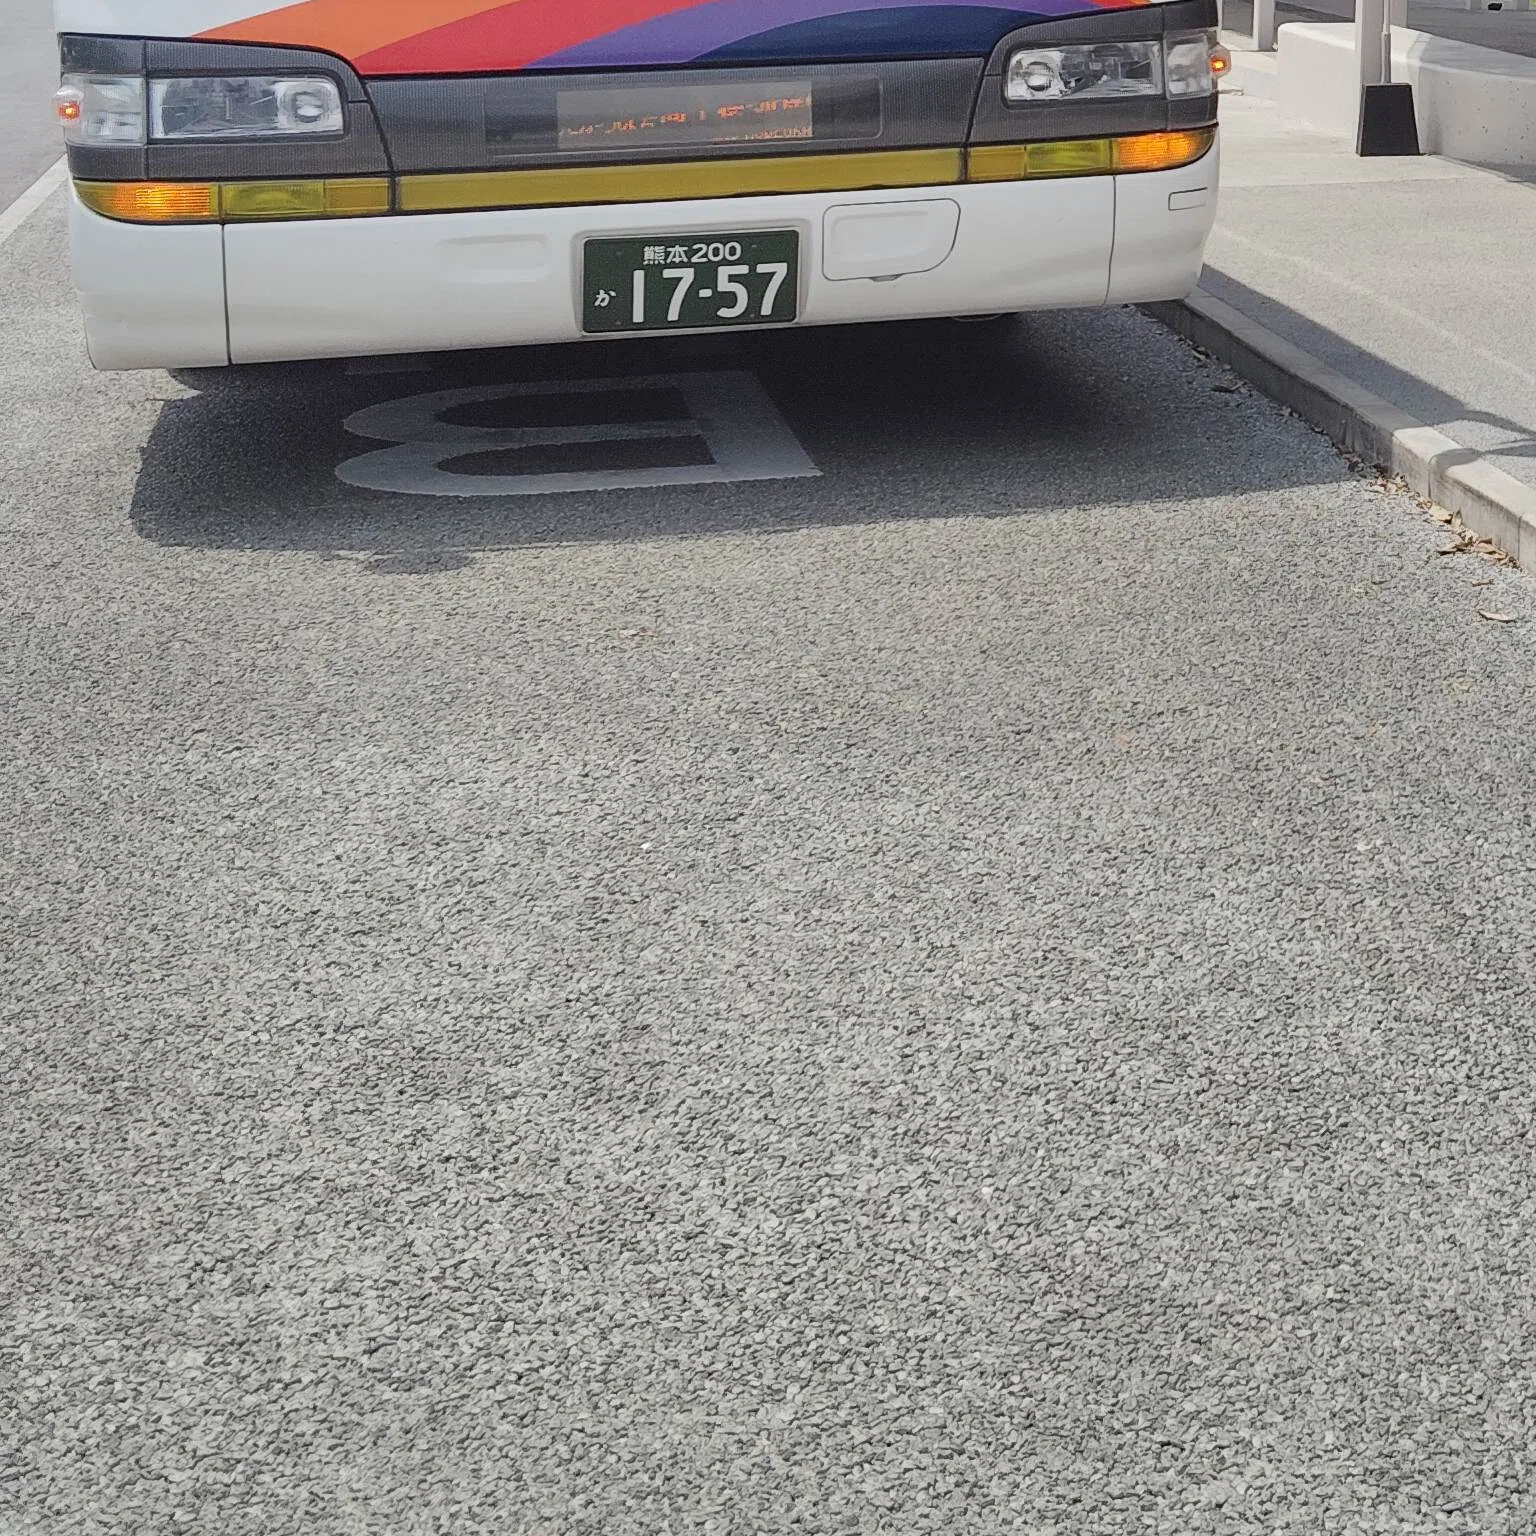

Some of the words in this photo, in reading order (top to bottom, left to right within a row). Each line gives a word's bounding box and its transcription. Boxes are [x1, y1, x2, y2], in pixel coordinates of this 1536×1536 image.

[643, 241, 742, 265] 熊本200
[594, 289, 617, 307] か
[632, 262, 788, 323] 17-57
